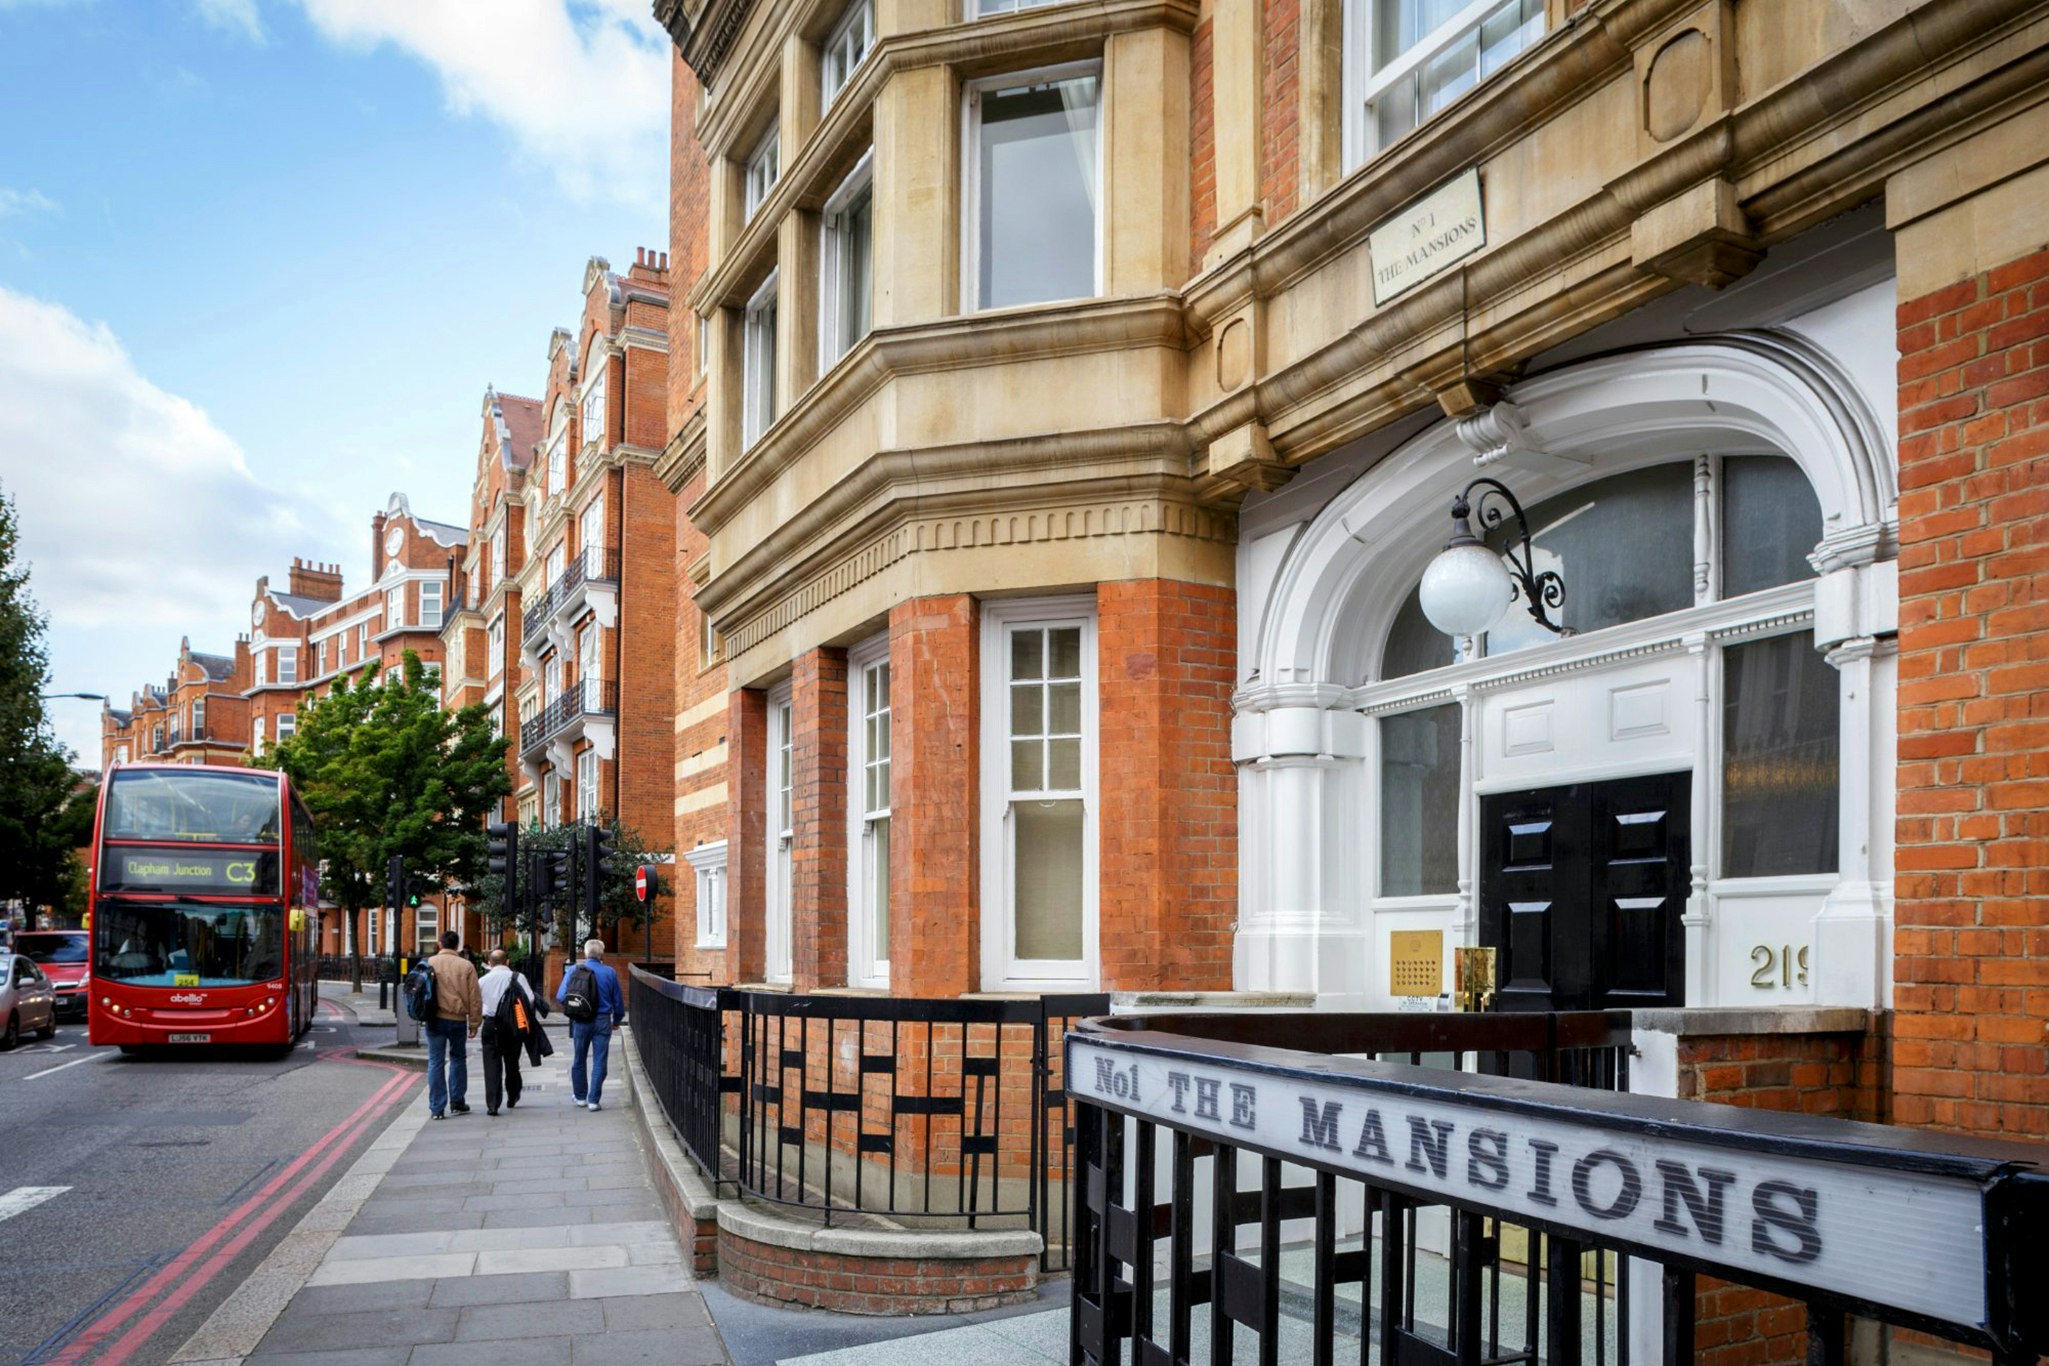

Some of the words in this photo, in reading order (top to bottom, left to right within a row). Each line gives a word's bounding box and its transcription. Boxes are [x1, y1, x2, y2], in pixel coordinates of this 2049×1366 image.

[1378, 265, 1402, 284] THE
[1405, 216, 1477, 270] MANSIONS
[128, 861, 169, 877] Clapham
[173, 863, 212, 876] Junction
[226, 862, 256, 882] C3
[1094, 1056, 1142, 1101] No1
[1168, 1071, 1256, 1130] THE
[1298, 1095, 1823, 1265] MANSIONS
